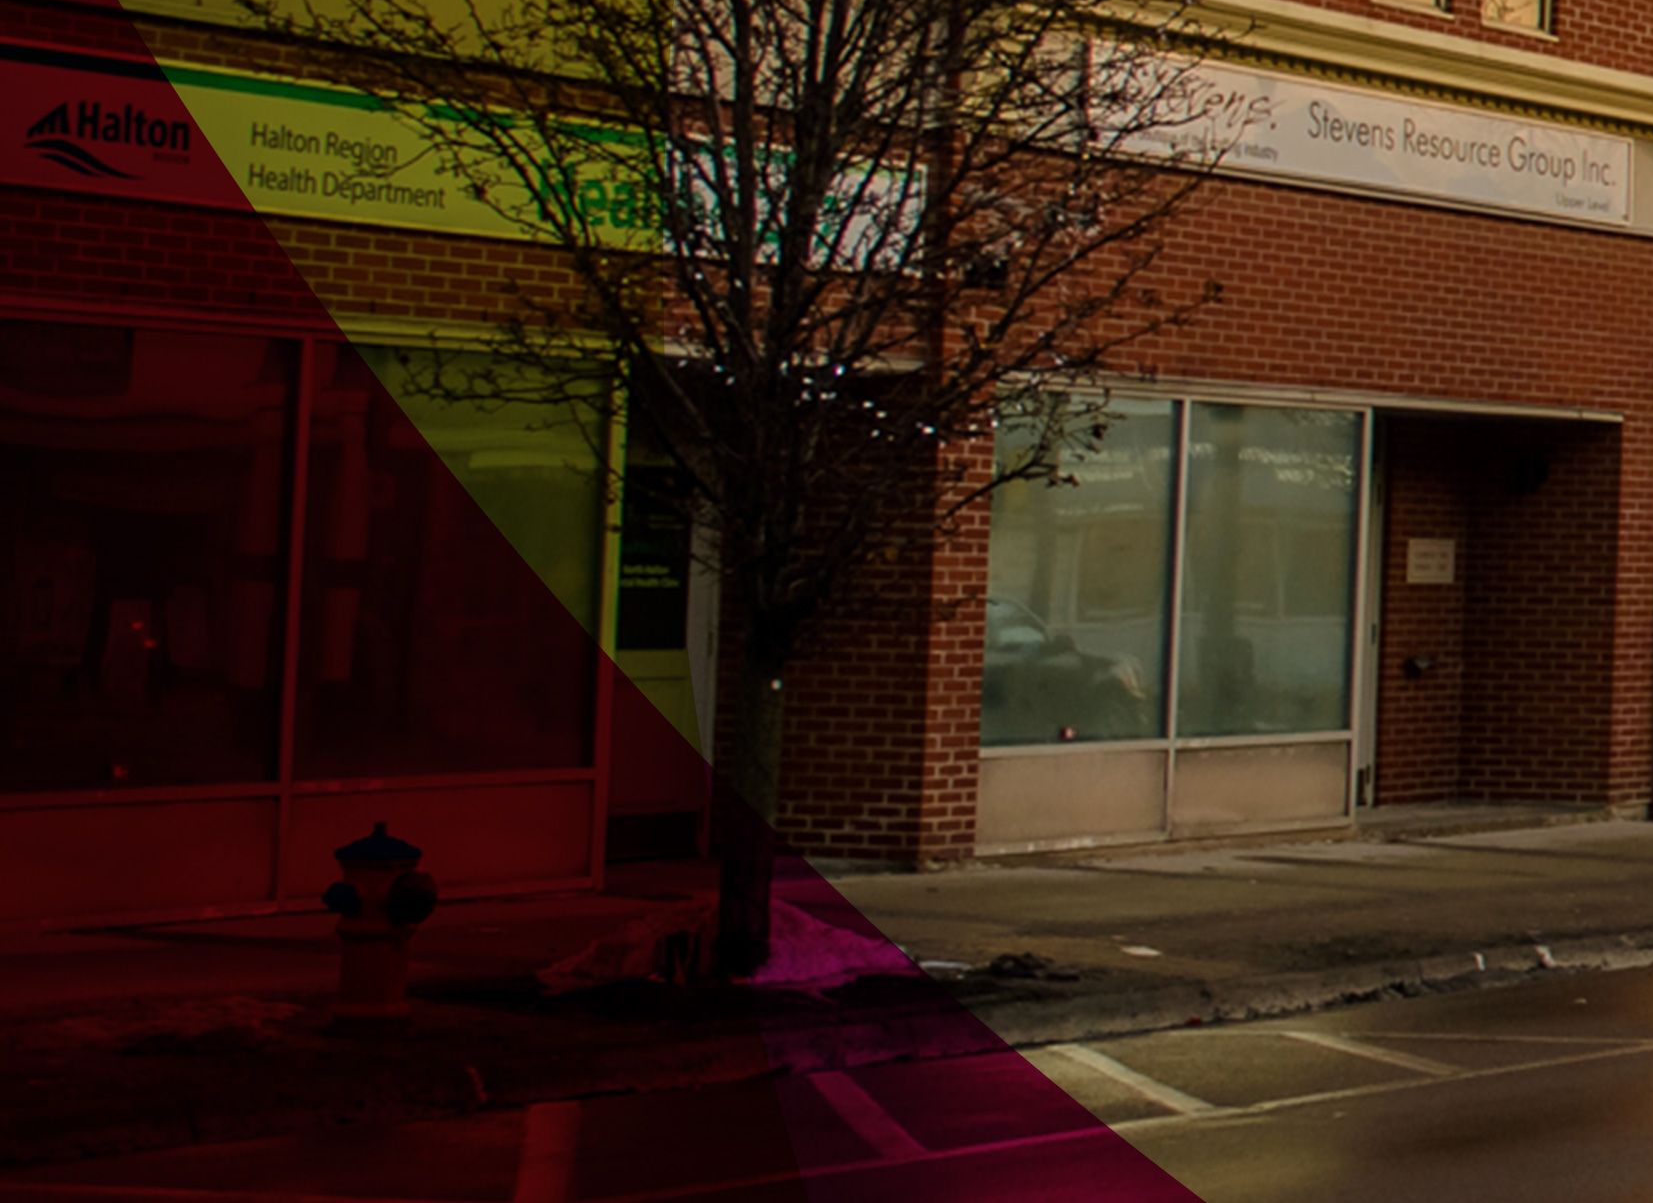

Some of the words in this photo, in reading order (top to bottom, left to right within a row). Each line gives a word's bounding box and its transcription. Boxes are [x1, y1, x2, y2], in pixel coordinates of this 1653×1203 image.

[77, 100, 190, 151] Halton
[251, 122, 320, 154] Halton
[326, 131, 397, 166] Region
[1308, 101, 1395, 152] Stevens
[1403, 118, 1501, 168] Resource
[1507, 136, 1575, 187] Group
[1582, 150, 1617, 187] Inc.
[248, 163, 316, 194] Health
[322, 171, 446, 209] Department
